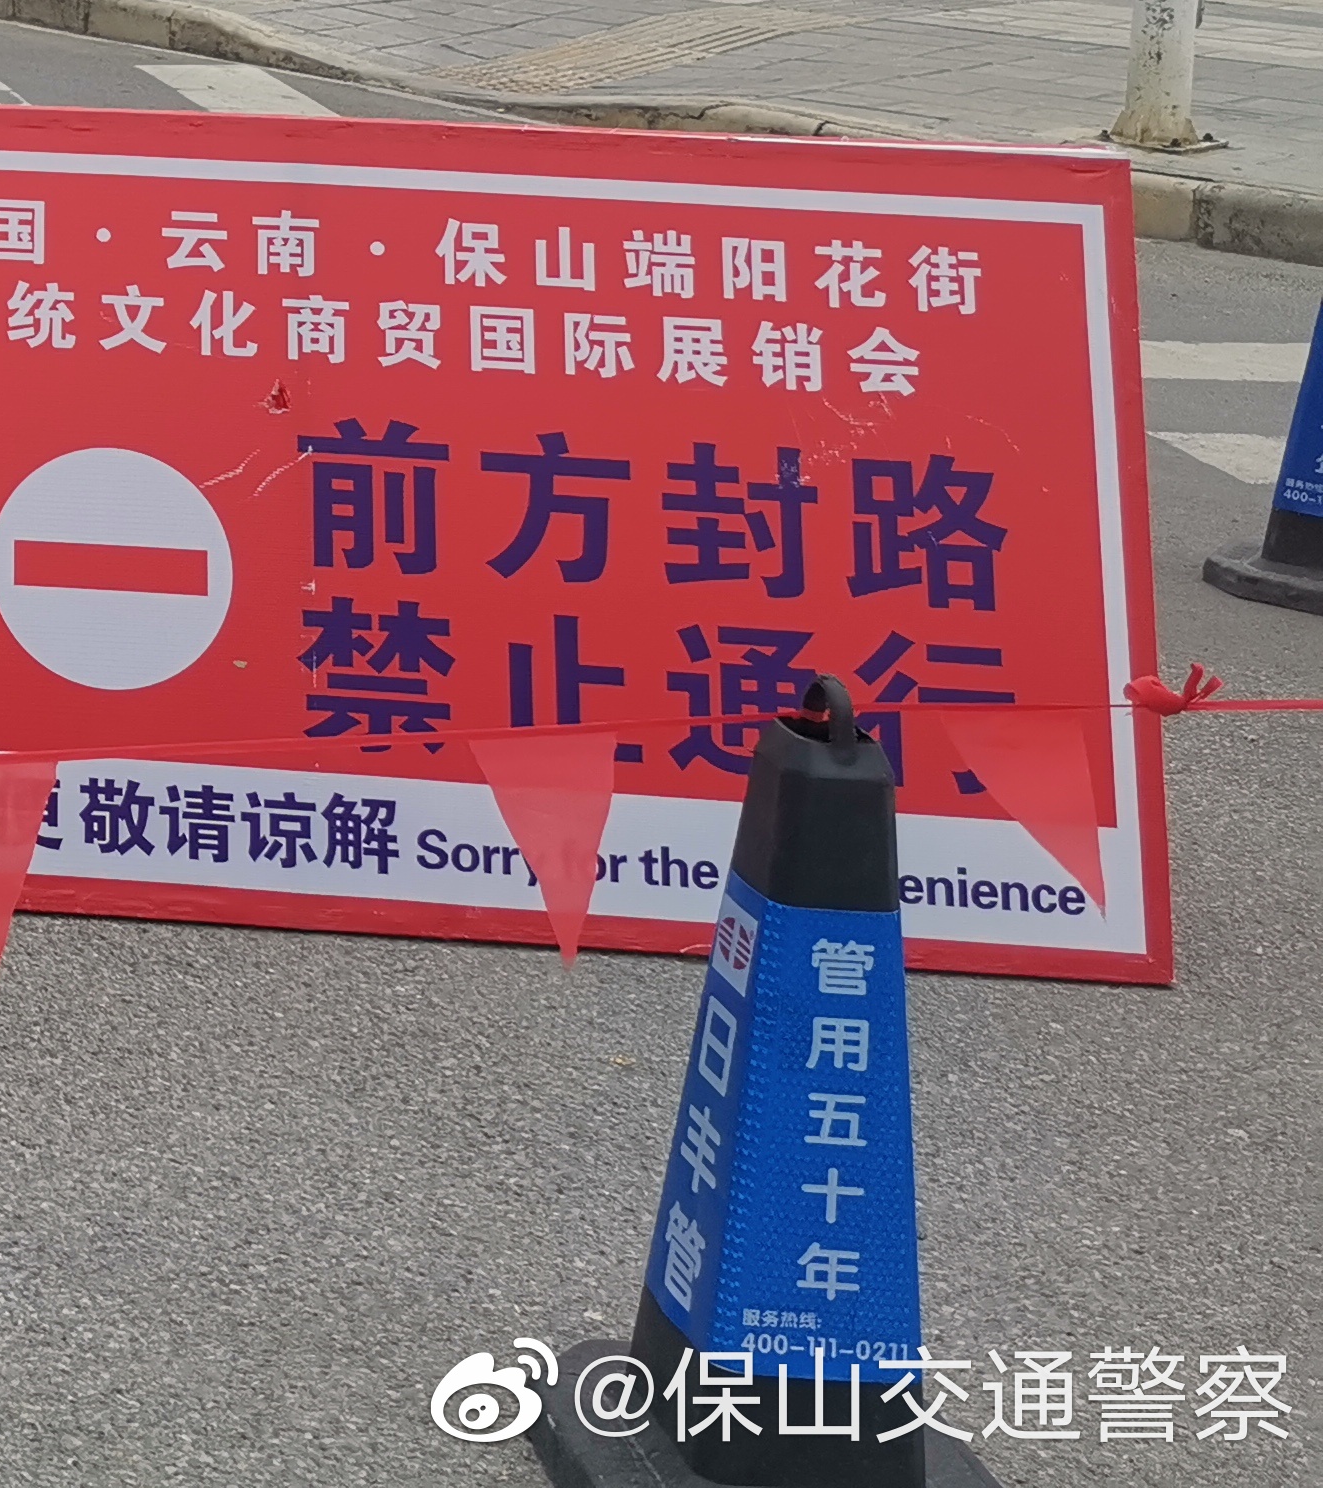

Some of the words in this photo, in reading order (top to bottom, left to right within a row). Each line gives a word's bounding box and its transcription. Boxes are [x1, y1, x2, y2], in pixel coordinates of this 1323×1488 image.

[296, 417, 1010, 612] 前方封路
[296, 597, 1015, 795] 禁止通行
[640, 844, 720, 889] the
[898, 866, 1086, 917] enience
[664, 994, 738, 1313] 日丰管
[795, 937, 876, 1302] 管用五十年
